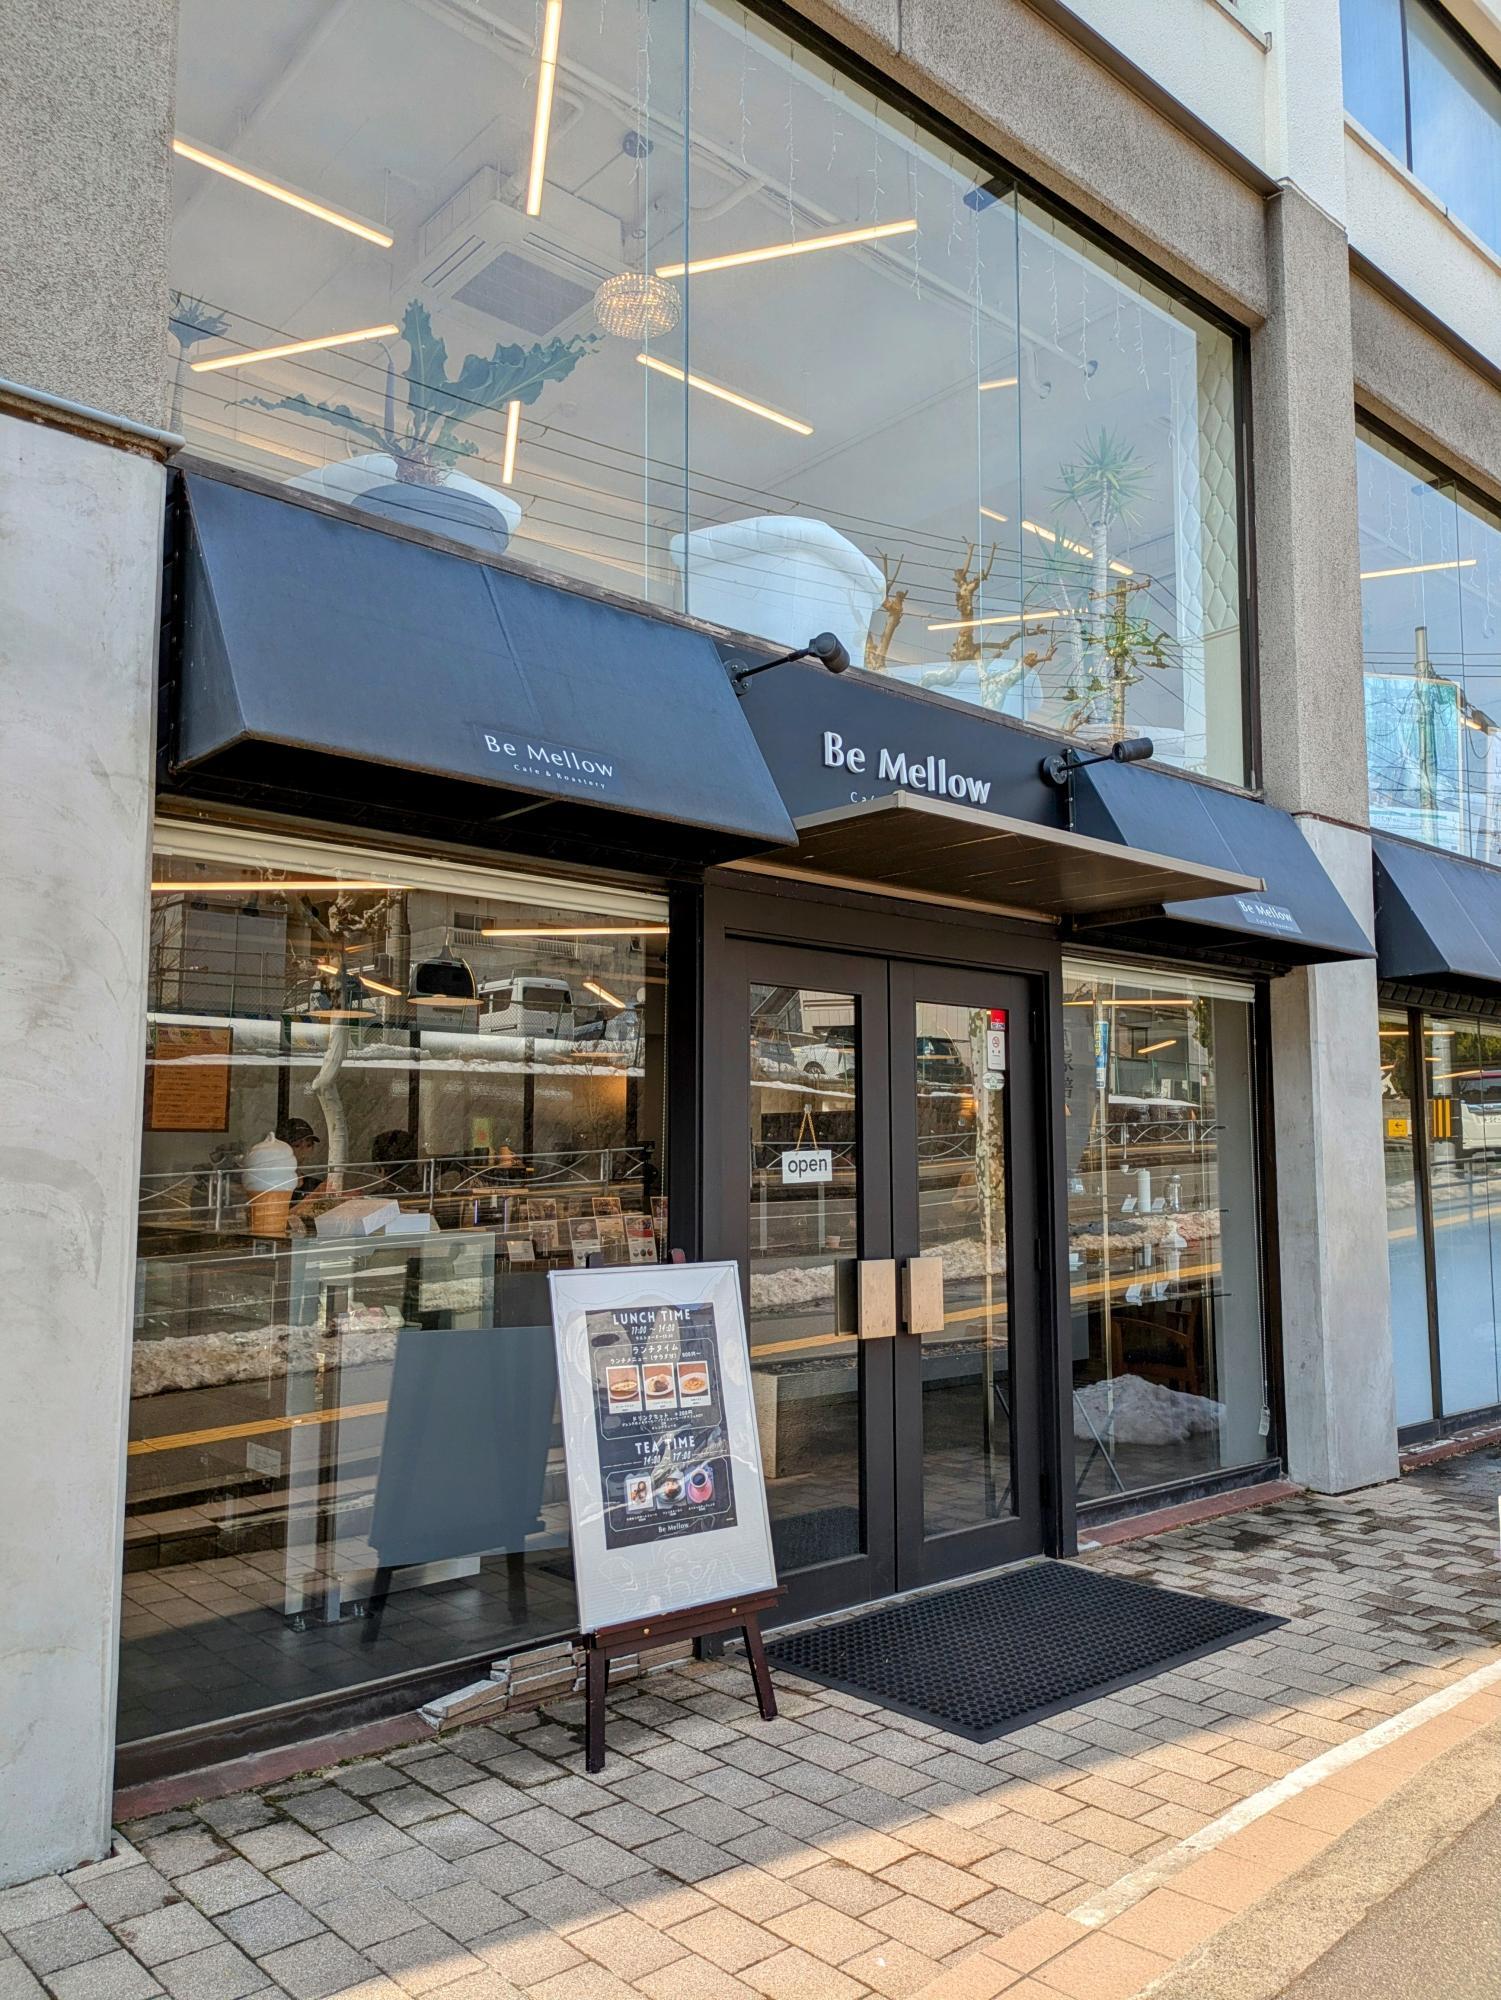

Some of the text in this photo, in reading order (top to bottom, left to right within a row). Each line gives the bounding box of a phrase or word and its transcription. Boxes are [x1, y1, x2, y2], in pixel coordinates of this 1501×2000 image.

[484, 734, 613, 777] Be Mellow
[823, 731, 991, 804] Be Mellow
[1238, 900, 1293, 922] Be Mellow
[788, 1158, 827, 1178] open
[613, 1309, 691, 1325] LUNCH TIME
[632, 1343, 679, 1355] ランチタイム
[635, 1435, 696, 1455] TEA TIME
[658, 1525, 667, 1533] Be
[668, 1523, 689, 1531] Mellow
